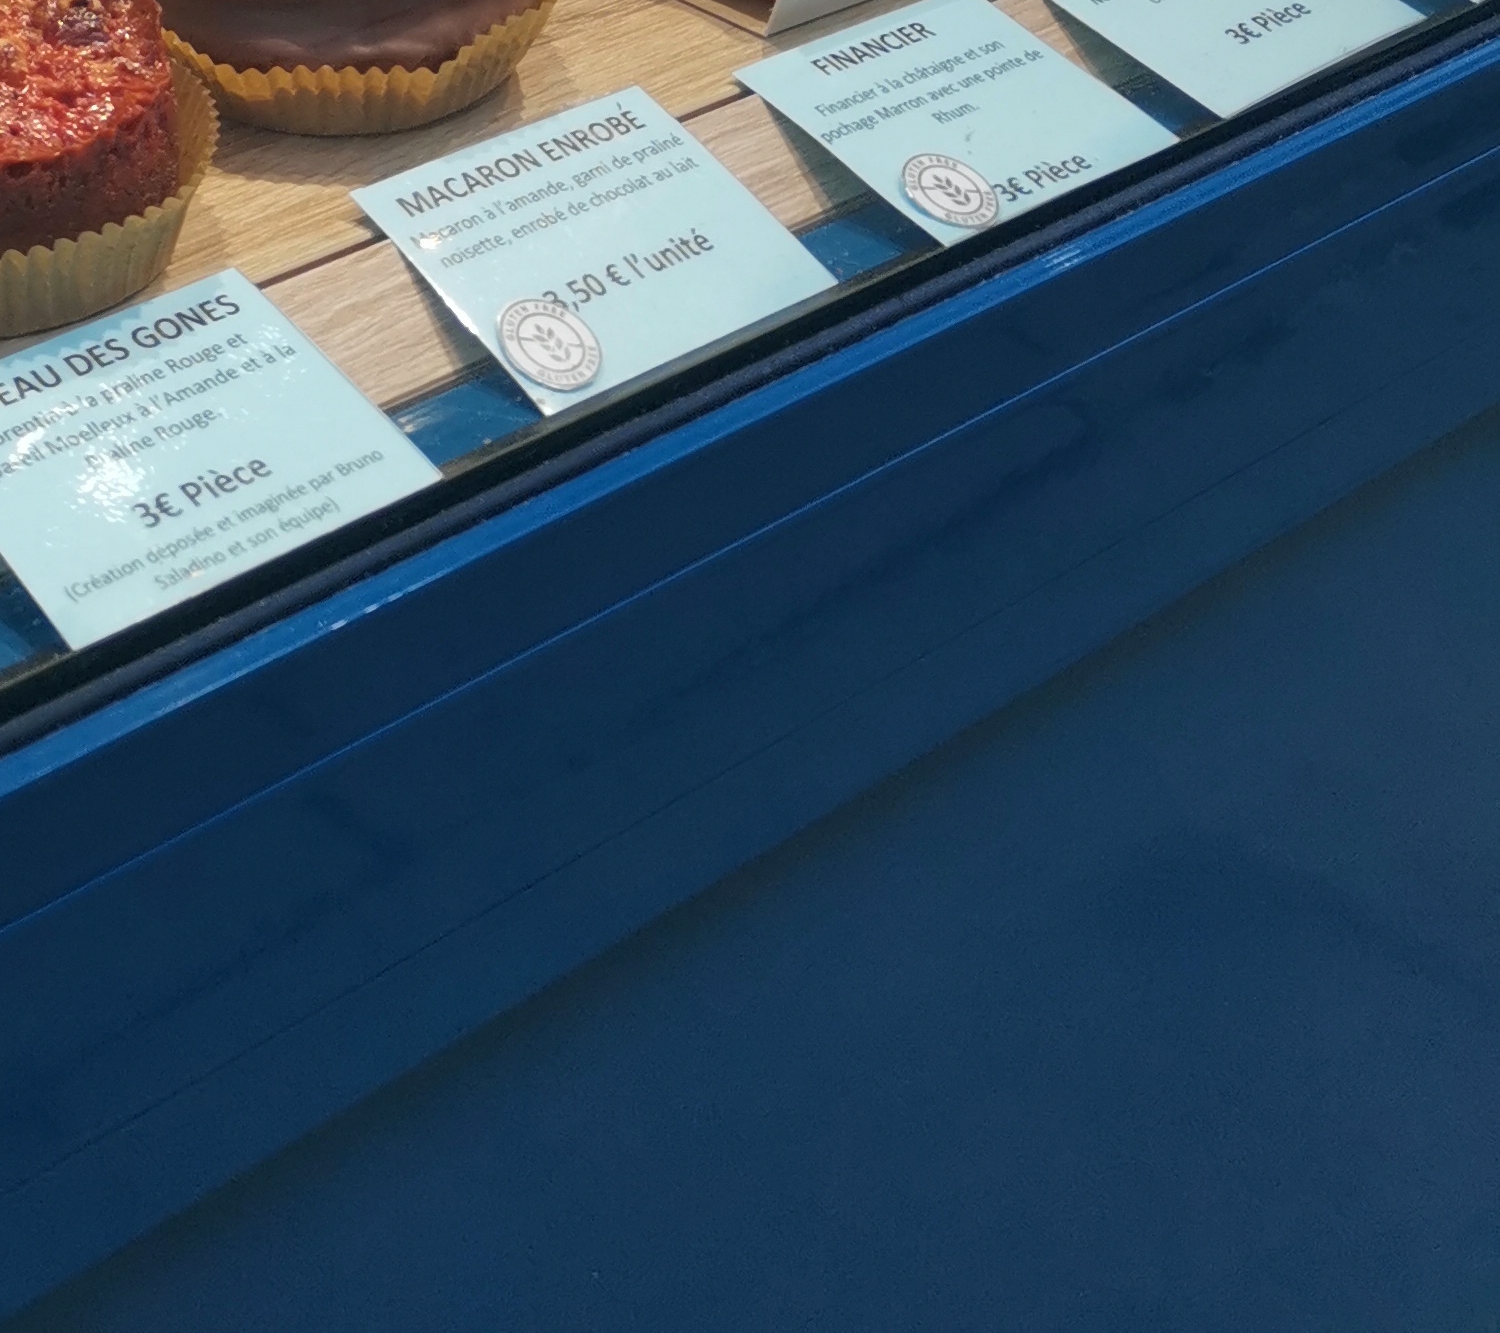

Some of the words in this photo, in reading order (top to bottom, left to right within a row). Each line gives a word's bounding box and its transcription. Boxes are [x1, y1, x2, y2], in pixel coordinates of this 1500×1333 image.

[810, 21, 937, 76] FINANCIER
[1225, 20, 1263, 45] 3€
[814, 86, 878, 117] Financier
[877, 81, 890, 94] à
[889, 78, 905, 91] la
[902, 55, 965, 85] châtaigne
[963, 48, 981, 62] et
[980, 39, 1006, 56] son
[820, 114, 879, 145] pochage
[873, 93, 929, 121] Marron
[927, 83, 961, 102] avec
[958, 72, 986, 89] une
[982, 55, 1027, 81] pointe
[1023, 47, 1044, 62] de
[395, 149, 543, 218] MACARON
[538, 101, 647, 162] ENROBÉ
[482, 206, 497, 221] à
[496, 179, 574, 216] l'amande,
[572, 161, 613, 188] garni
[612, 153, 634, 170] de
[632, 132, 685, 164] praliné
[994, 176, 1034, 204] 3€
[1028, 152, 1093, 195] Pièce
[440, 229, 513, 269] noisette,
[511, 205, 568, 240] enrobé
[567, 200, 590, 216] de
[589, 174, 654, 208] chocolat
[652, 167, 673, 183] au
[672, 155, 700, 173] lait
[604, 263, 632, 287] €
[622, 227, 715, 280] l'unité
[63, 337, 131, 377] DES
[131, 293, 241, 349] GONES
[43, 411, 137, 456] Moelleux
[136, 401, 152, 419] à
[148, 365, 241, 413] l'Amande
[240, 356, 264, 374] et
[262, 348, 278, 365] à
[273, 341, 297, 361] la
[63, 555, 146, 603] (Création
[145, 523, 216, 567] déposée
[216, 513, 240, 533] et
[236, 485, 309, 525] imaginée
[307, 469, 337, 494] par
[334, 448, 385, 478] Bruno
[131, 491, 184, 530] 3€
[178, 457, 273, 508] Pièce
[153, 548, 227, 591] Saladino
[228, 538, 248, 559] et
[249, 526, 280, 549] son
[277, 495, 342, 535] équipe)
